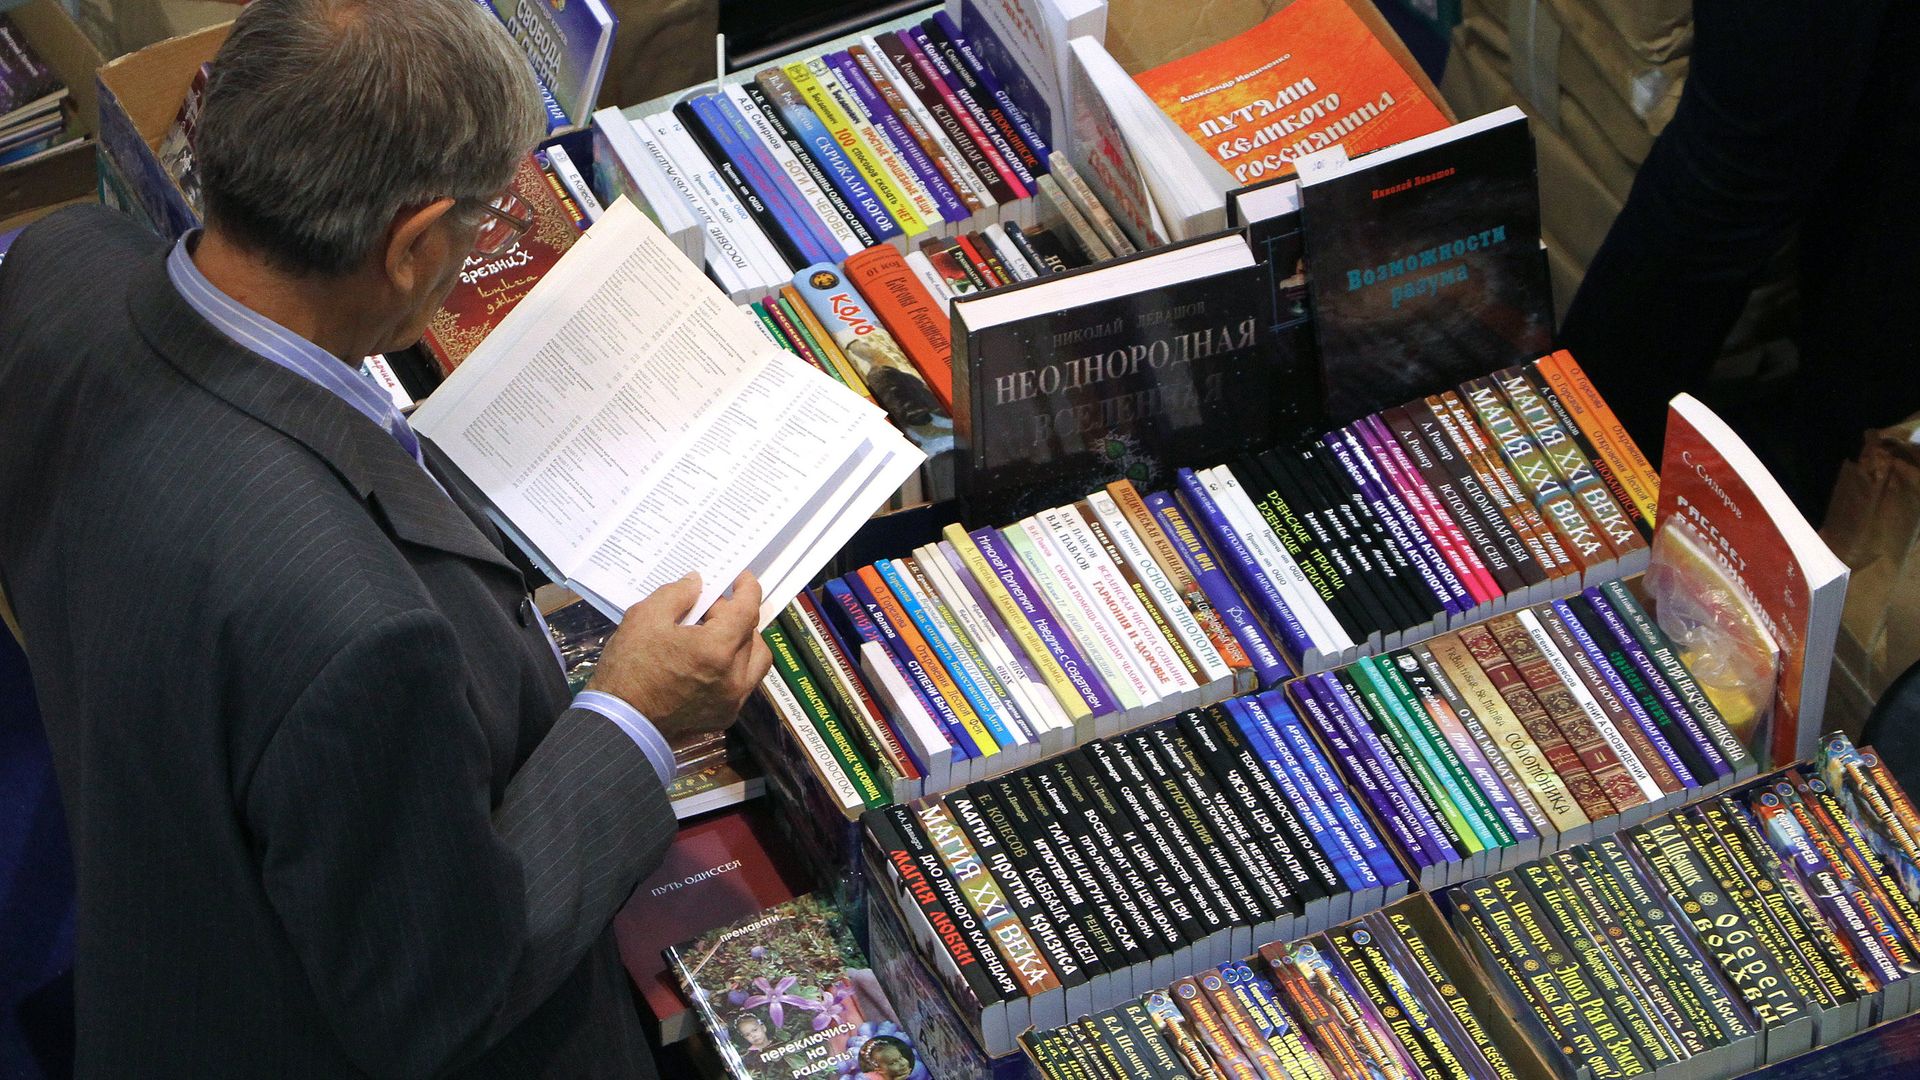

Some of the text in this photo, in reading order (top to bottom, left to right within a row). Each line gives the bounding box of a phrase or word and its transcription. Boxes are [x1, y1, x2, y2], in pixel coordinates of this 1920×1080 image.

[995, 90, 1046, 150] СТУПЕНИ БЫТИЯ
[1179, 53, 1292, 102] Александр Иванченко
[1199, 76, 1318, 139] ПУТЯМИ
[835, 128, 856, 147] 100
[932, 103, 1000, 185] ВСПОМИНАЯ СЕБЯ
[956, 88, 1035, 184] КИТАЙСКАЯ АСТРОЛОГИЯ
[988, 108, 1039, 169] АПОКАЛИПСИС
[1218, 92, 1342, 160] ВЕЛИКОГО
[751, 113, 782, 151] Смирнов
[784, 159, 805, 181] БОГИ
[804, 182, 819, 196] И
[816, 198, 854, 242] ЧЕЛОВЕК
[787, 139, 875, 246] ДВЕ ПОЛОВИНЫ ОДНОГО ОТВЕТА
[815, 136, 895, 232] СКРИЖАЛИ БОГОВ
[912, 189, 934, 217] ВЕЩИ
[931, 172, 960, 210] МАССАЖ
[1346, 225, 1508, 292] Возможности
[995, 316, 1258, 407] НЕОДНОРОДНАЯ
[1469, 386, 1602, 558] МАГИЯ XXI ВЕКА
[1502, 376, 1635, 546] МАГИЯ XXI ВЕКА
[1696, 464, 1743, 519] Сидоров
[1257, 501, 1336, 602] ДЗЕНСКИЕ ПРИТЧИ
[1267, 489, 1345, 590] ДЗЕНСКИЕ ПРИТЧИ
[1372, 500, 1452, 604] КИТАЙСКАЯ АСТРОЛОГИЯ
[1387, 494, 1467, 598] КИТАЙСКАЯ АСТРОЛОГИЯ
[1439, 483, 1509, 570] ВСПОМИНАЯ СЕБЯ
[1460, 475, 1530, 563] ВСПОМИНАЯ СЕБЯ
[1677, 495, 1747, 572] РАССВЕТ
[1092, 581, 1133, 630] ГАРМОНИЯ
[1134, 635, 1170, 685] ЗДОРОВЬЕ
[1140, 559, 1178, 606] ОСНОВЫ
[1171, 605, 1222, 669] ЭНИОЛОГИИ
[865, 603, 961, 726] А. Волков СТУПЕНИ БЫТИЯ
[915, 644, 950, 688] Откровения
[968, 719, 983, 735] Феи
[1064, 660, 1102, 709] Создателем
[1574, 651, 1623, 713] ОШИБКА БОГОВ
[1655, 648, 1746, 762] МАГИЯ НЕКРОНОМИКОНА
[797, 676, 882, 802] ГИМНАСТИКА СЛАВЯНСКИХ ЧАРОВНИЦ
[799, 723, 855, 799] ДРЕВНЕГО ВОСТОКА
[1286, 723, 1377, 850] АРХЕТИПИЧЕСКИЕ ПУТЕШЕСТВИЯ
[1504, 732, 1571, 816] СОЛОМОНИКА
[1584, 701, 1648, 780] КНИГА СНОВИДЕНИЙ
[954, 798, 997, 848] МАГИЯ
[1227, 769, 1310, 883] ЧЖЭНЬ ЦЗЮ ТЕРАПИЯ
[1247, 700, 1377, 883] АРХЕТИПИЧЕСКОЕ ИССЛЕДОВАНИЕ АРКАНОВ ТАРО
[1267, 758, 1324, 834] АРХЕТИПОТЕРАПИЯ
[651, 859, 743, 898] ПУТЬ ОДИССЕЯ
[1033, 837, 1084, 906] ИГЛОТЕРАПИЯ
[1047, 821, 1139, 952] ТАЙ ЦЗИ ЦИГУН МАССАЖ
[1083, 808, 1178, 944] ВОСЕМЬ ВРАТ ТАЙ ЦЗИ ЦЮАНЬ
[1214, 791, 1291, 898] ЧУДЕСНЫЕ МЕРИДИАНЫ
[890, 849, 977, 966] МАГИЯ ЛЮБВИ
[917, 804, 1049, 987] МАГИЯ XXI ВЕКА
[919, 853, 1017, 994] ДАО ЛУННОГО КАЛЕНДАРЯ
[1025, 867, 1100, 964] КАББАЛА ЧИСЕЛ
[1816, 872, 1901, 982] СМЕНА ПОЛЮСОВ И ВОЗНЕСЕНИЕ
[1851, 890, 1912, 965] ПОЛЕТЫ ДУШИ
[1715, 913, 1799, 1017] Обереги
[1555, 962, 1645, 1077] Эпоха Рая на Земле
